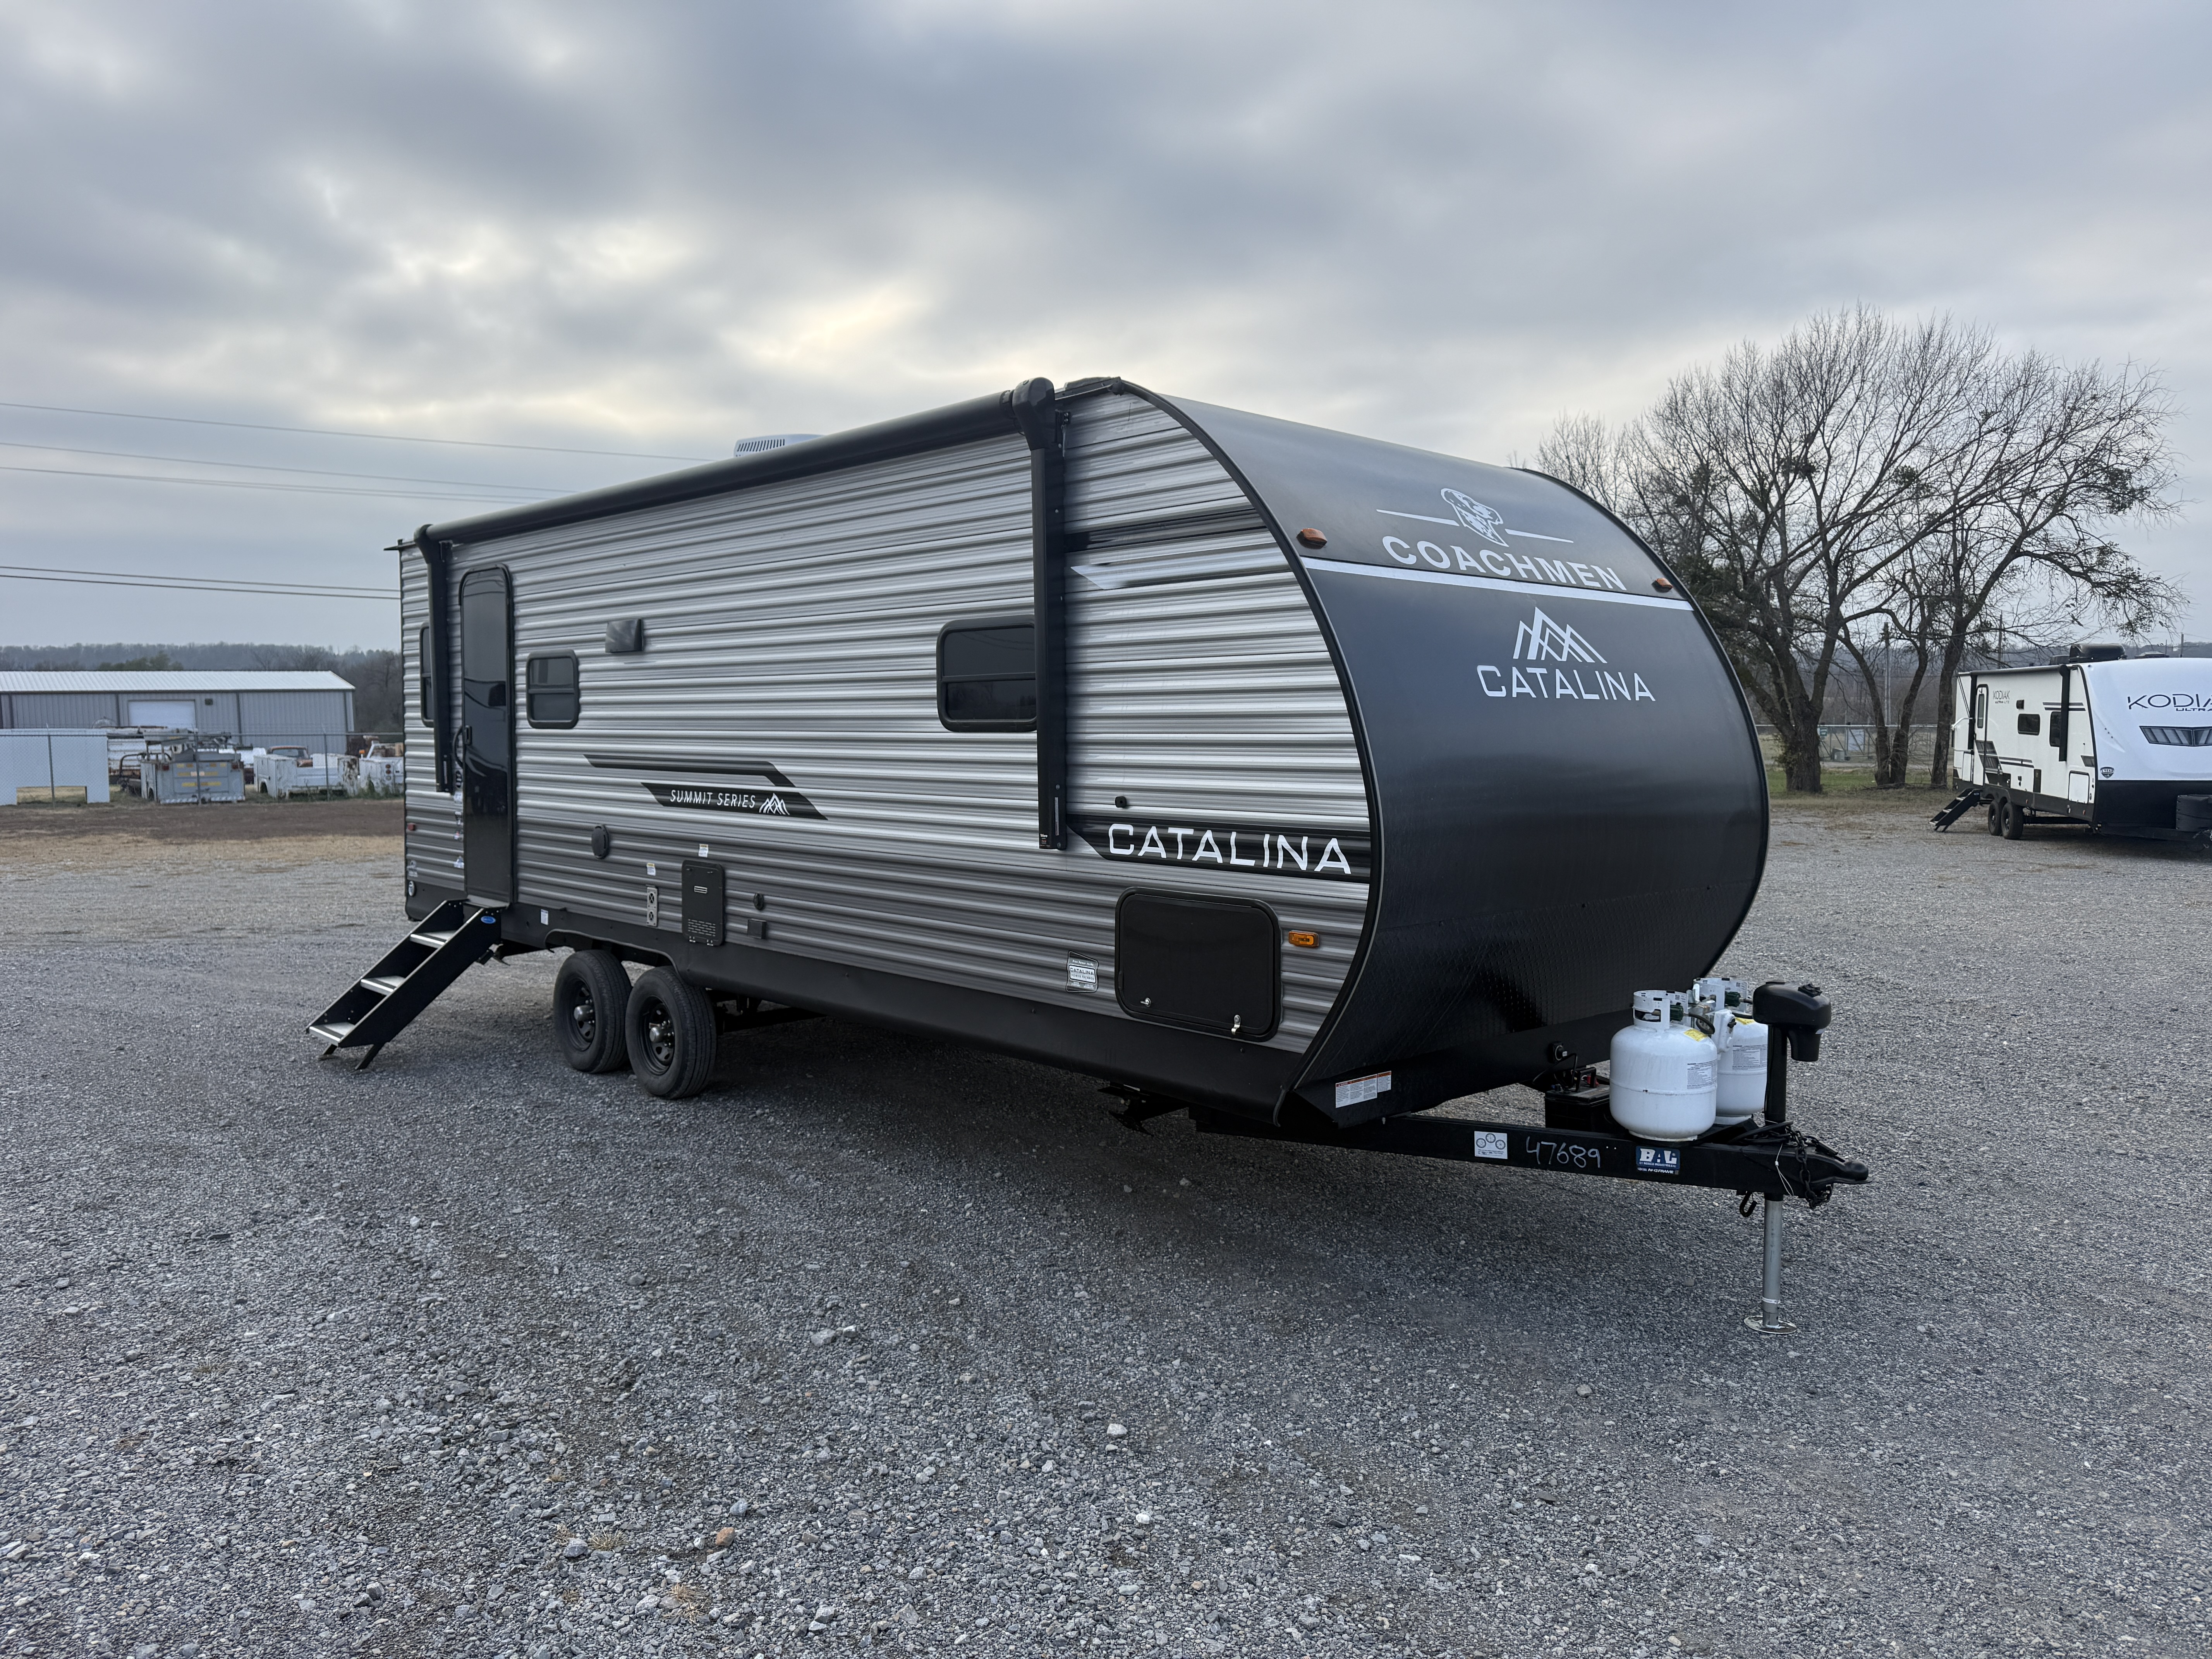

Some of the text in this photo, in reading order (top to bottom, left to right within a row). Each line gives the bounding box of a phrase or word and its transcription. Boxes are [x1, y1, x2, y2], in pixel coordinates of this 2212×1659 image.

[1382, 536, 1626, 591] COACHMEN
[1476, 665, 1656, 702] CATALINA
[670, 789, 756, 809] SUMMIT SERIES
[1108, 823, 1352, 874] CATALINA
[1526, 1136, 1601, 1168] 47689
[1639, 1148, 1677, 1164] BAL
